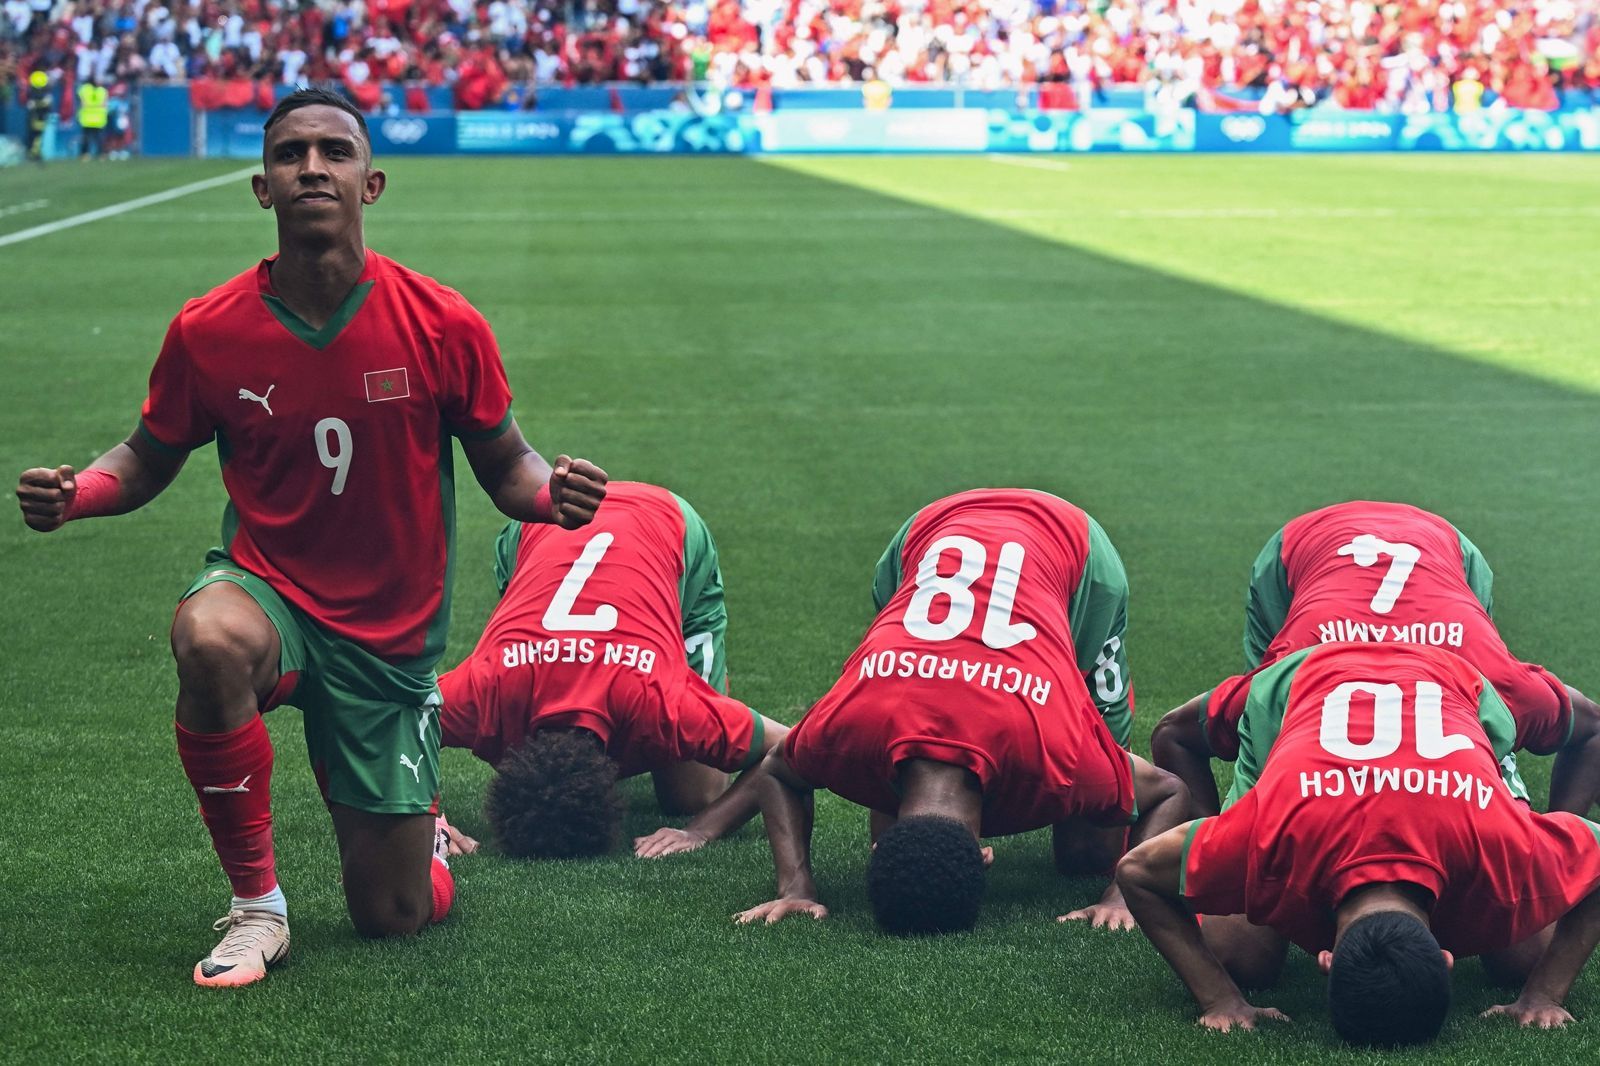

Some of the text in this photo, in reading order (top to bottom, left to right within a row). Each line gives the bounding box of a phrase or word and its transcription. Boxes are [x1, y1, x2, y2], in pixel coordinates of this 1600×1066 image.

[314, 417, 353, 496] 9
[542, 532, 618, 631] 7
[902, 535, 1038, 649] 18
[1337, 533, 1421, 614] 4
[502, 638, 657, 674] BEN SEGHIR
[685, 632, 714, 684] 7
[1318, 618, 1464, 647] BOUKAMIR
[859, 650, 1052, 706] RICHARDSON
[1319, 681, 1475, 760] 10
[1299, 765, 1494, 810] AKHOMACH
